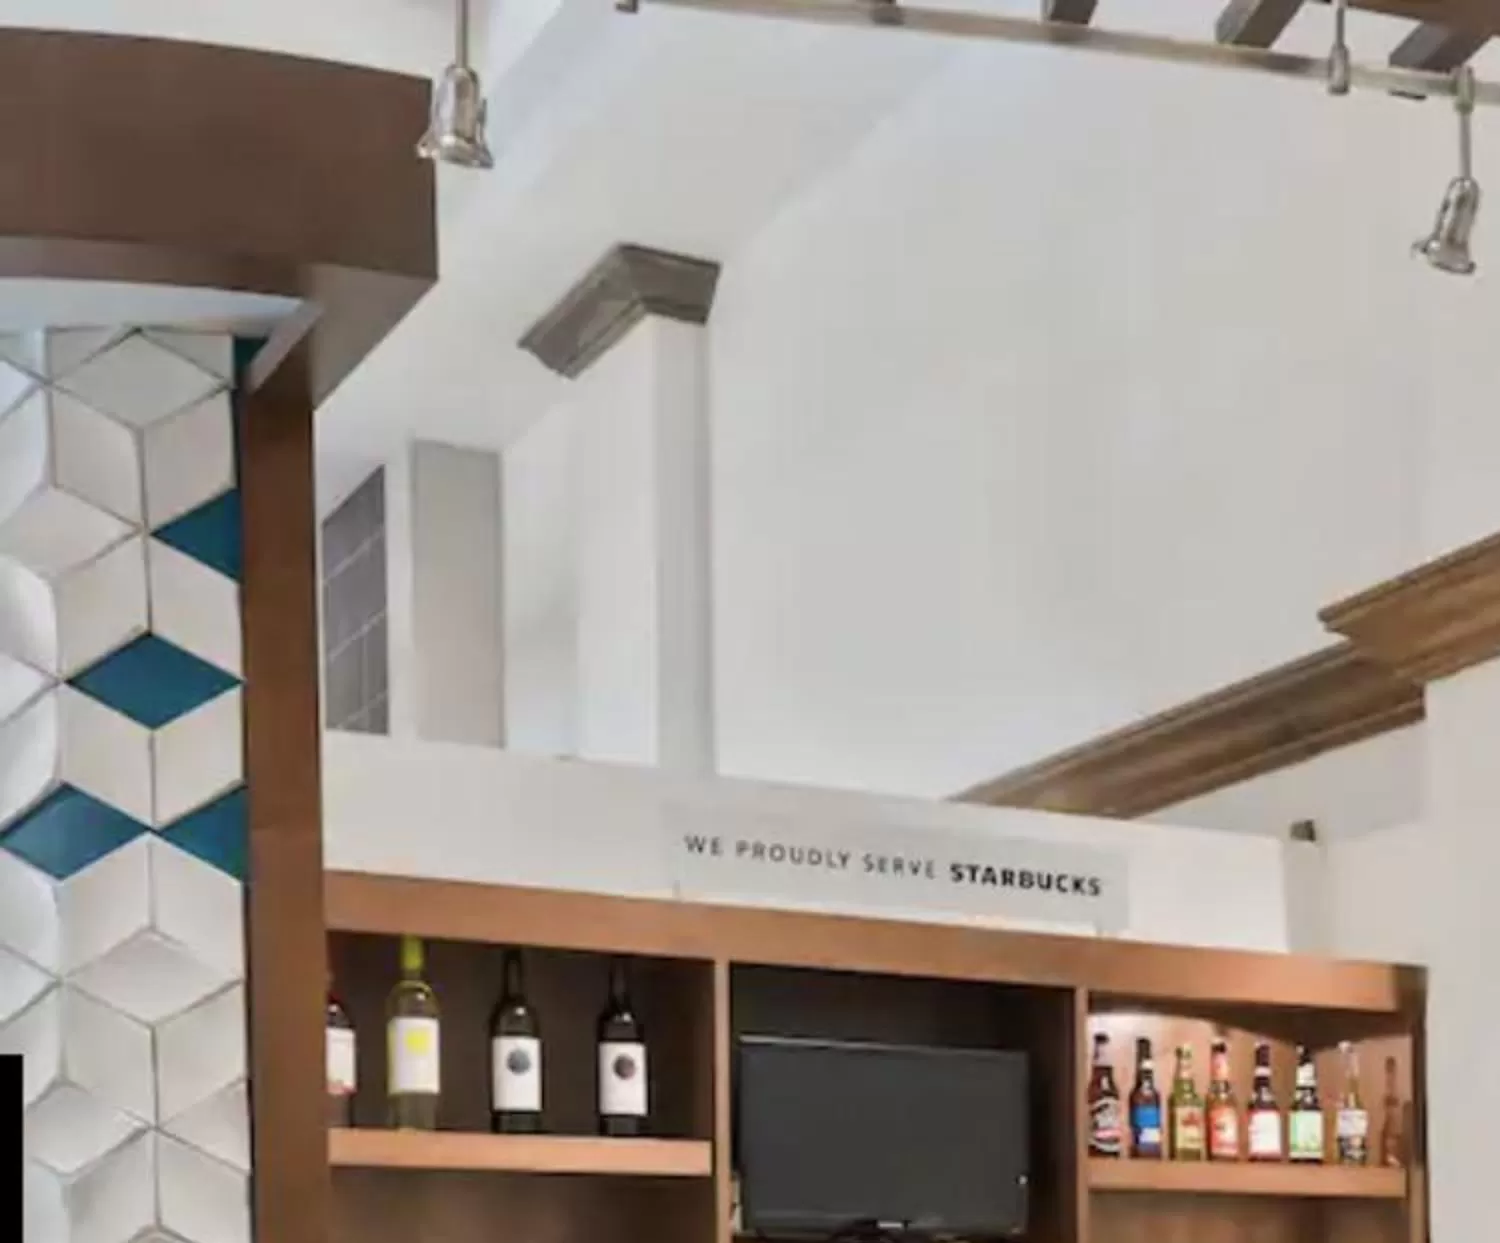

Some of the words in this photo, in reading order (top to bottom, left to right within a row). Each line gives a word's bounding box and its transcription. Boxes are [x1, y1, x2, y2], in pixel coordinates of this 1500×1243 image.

[684, 835, 722, 857] WE
[736, 839, 850, 869] PROUDLY
[862, 853, 935, 880] SERVE
[950, 863, 1102, 897] STARBUCKS
